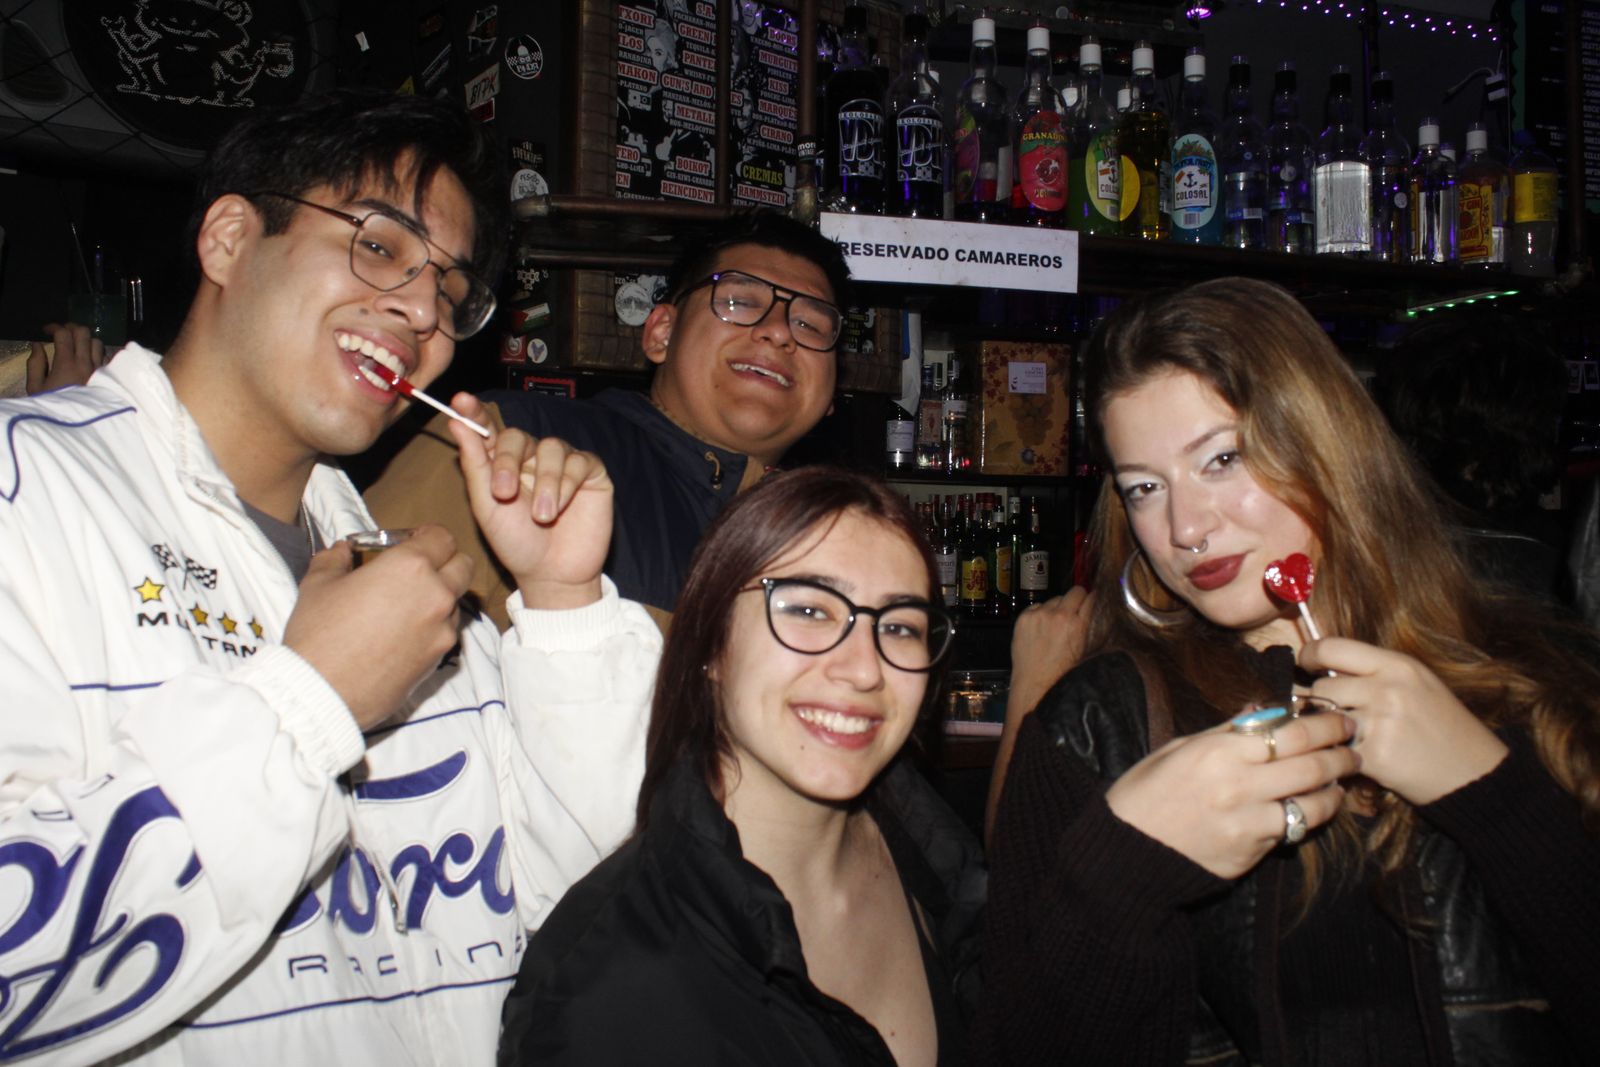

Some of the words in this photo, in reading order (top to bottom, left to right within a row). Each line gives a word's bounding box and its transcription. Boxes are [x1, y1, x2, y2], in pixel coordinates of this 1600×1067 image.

[680, 24, 709, 43] GREEN
[770, 79, 788, 94] KISS
[743, 165, 783, 186] CREMAS
[739, 186, 785, 205] RAMMSTEIN
[1176, 189, 1208, 201] COLOSAL
[839, 241, 949, 262] RESERVADO
[955, 248, 1062, 269] CAMAREROS
